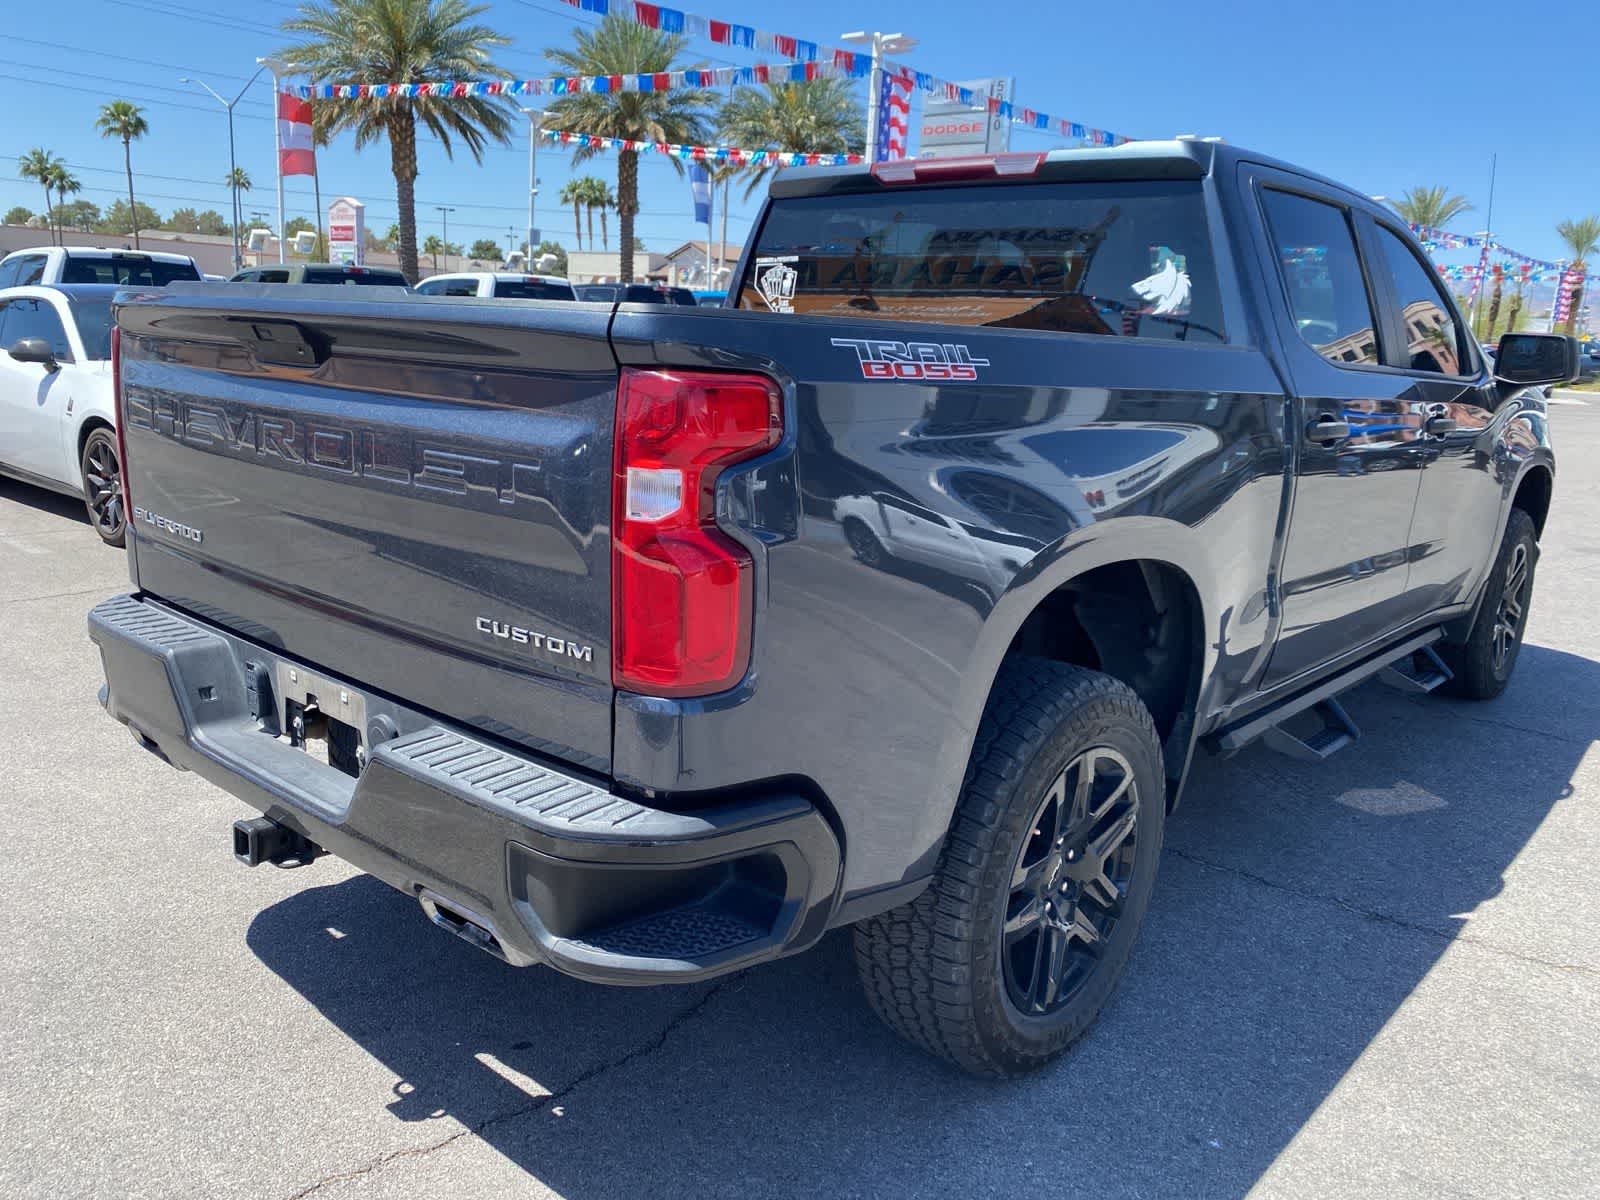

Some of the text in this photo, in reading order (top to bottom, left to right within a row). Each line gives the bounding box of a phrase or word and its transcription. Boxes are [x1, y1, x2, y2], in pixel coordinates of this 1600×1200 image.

[922, 122, 983, 135] DODGE
[830, 337, 990, 366] TRAIL
[862, 360, 977, 381] BOSS
[125, 383, 542, 504] CHEVROLET
[134, 506, 203, 543] SILVERADO
[476, 616, 593, 662] CUSTOM
